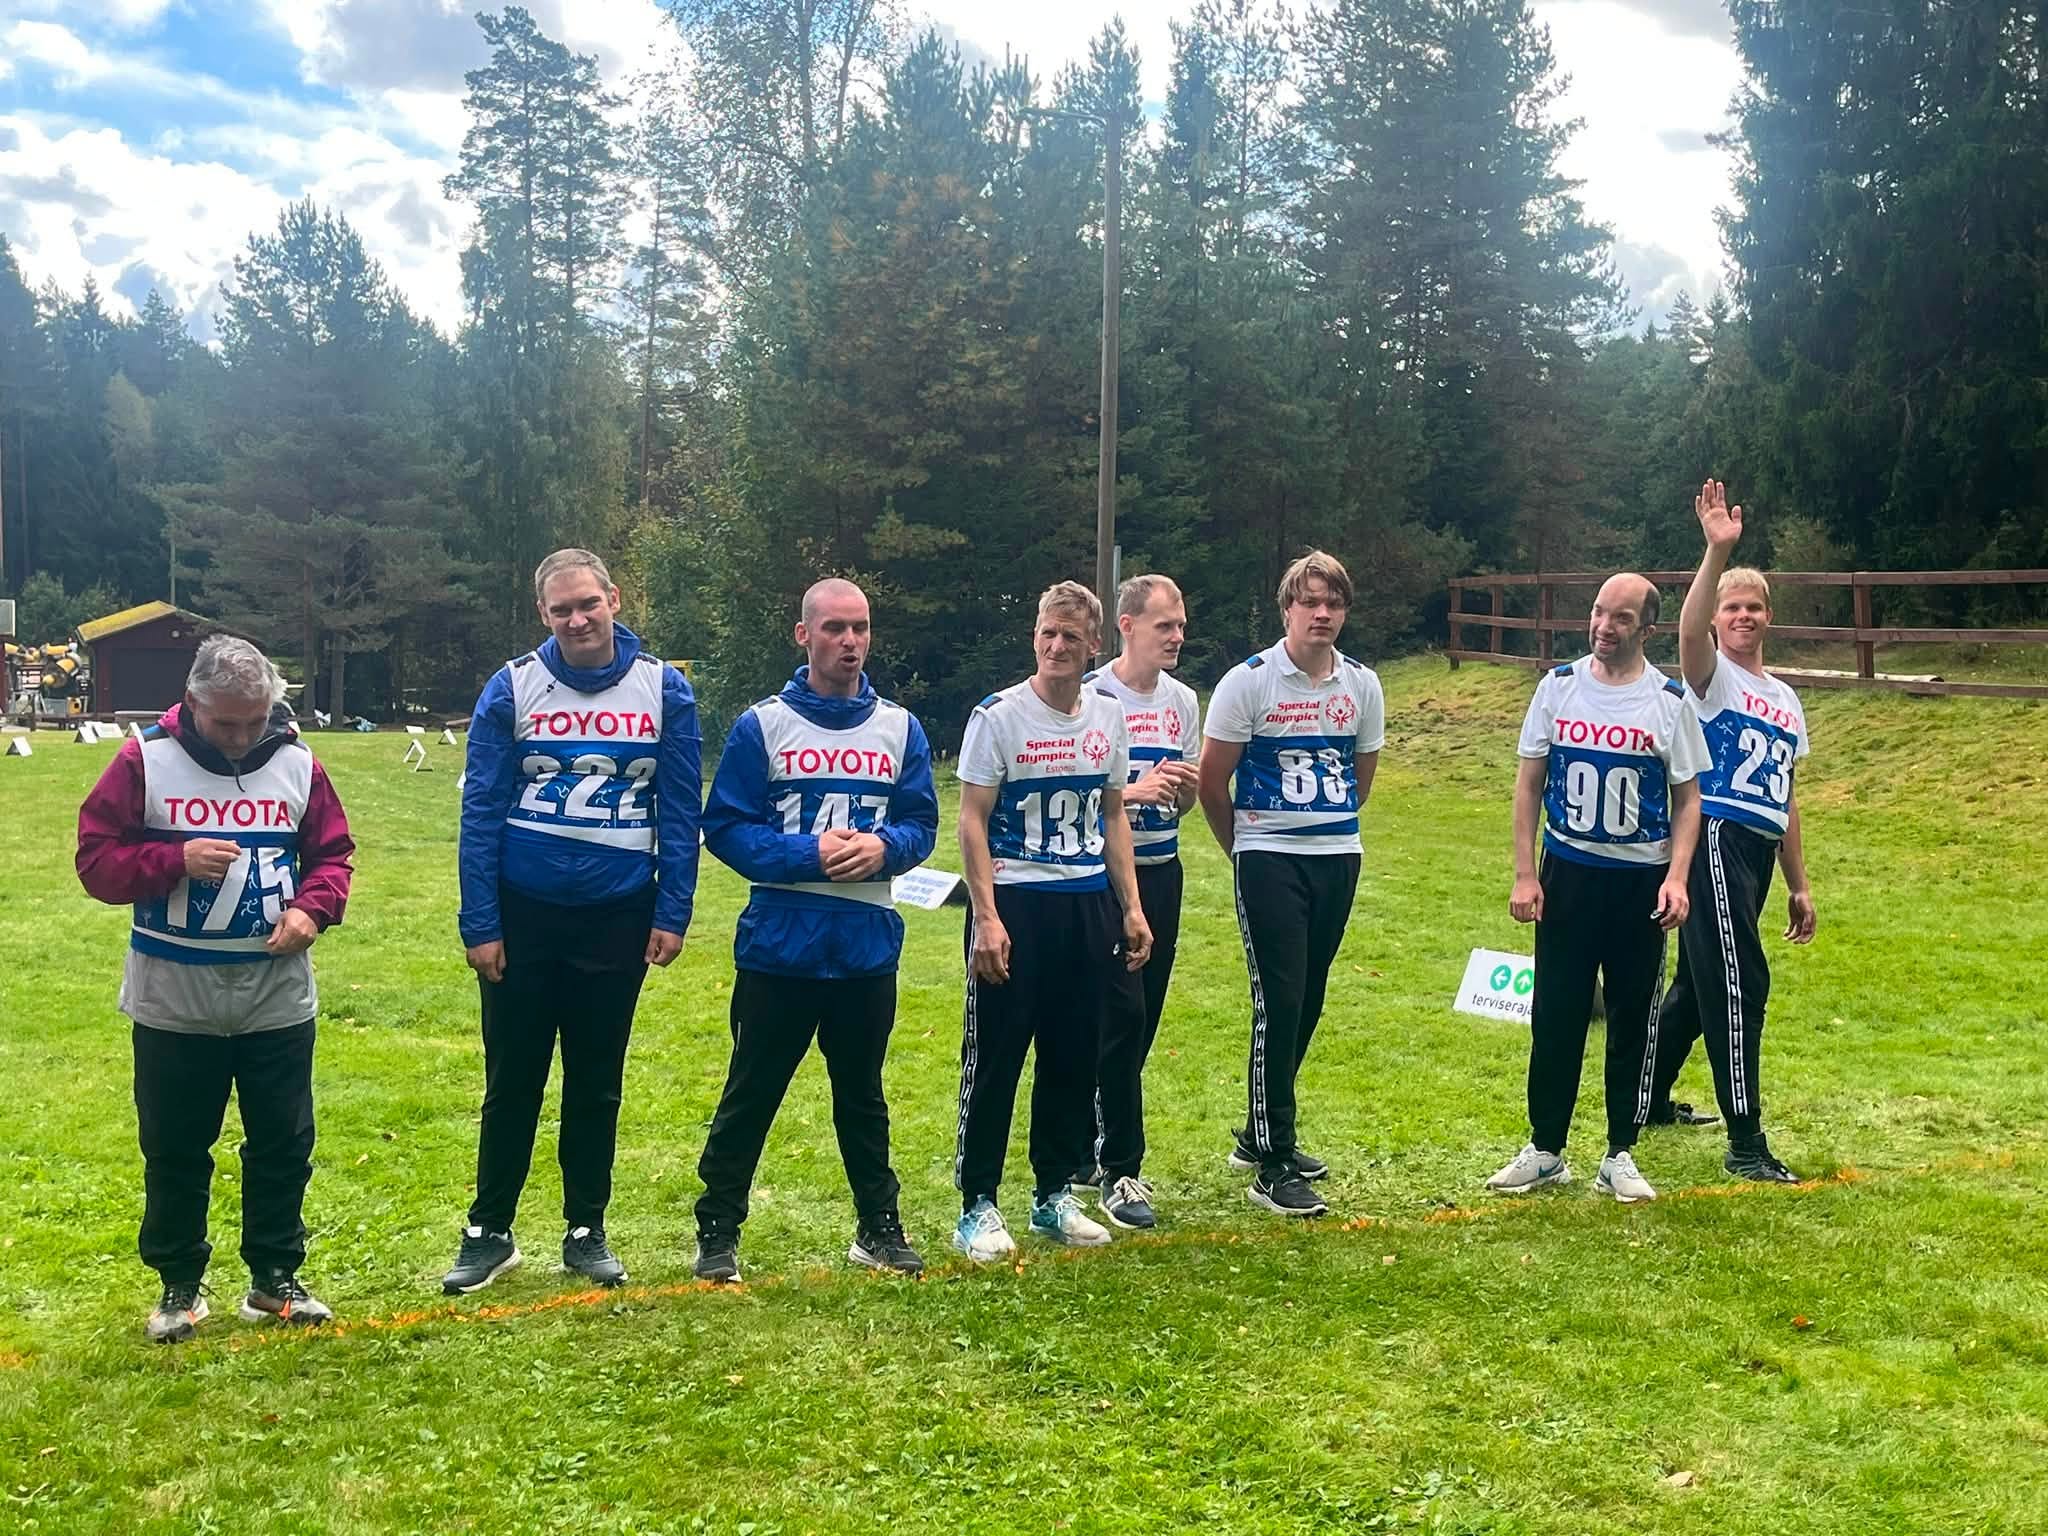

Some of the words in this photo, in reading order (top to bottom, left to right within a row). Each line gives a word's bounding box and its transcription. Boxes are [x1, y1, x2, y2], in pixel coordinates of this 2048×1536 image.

[1266, 713, 1319, 724] Olympics
[1277, 701, 1320, 713] Special
[530, 711, 656, 737] TOYOTA
[1556, 719, 1655, 751] TOYOTA
[1016, 751, 1076, 764] Olympics
[1026, 738, 1075, 751] Special
[780, 749, 892, 778] TOYOTA
[1046, 764, 1076, 773] Estonia
[1278, 748, 1349, 805] 83
[1731, 728, 1794, 804] 23
[519, 754, 657, 820] 222
[1566, 761, 1640, 837] 90
[164, 798, 292, 827] TOYOTA
